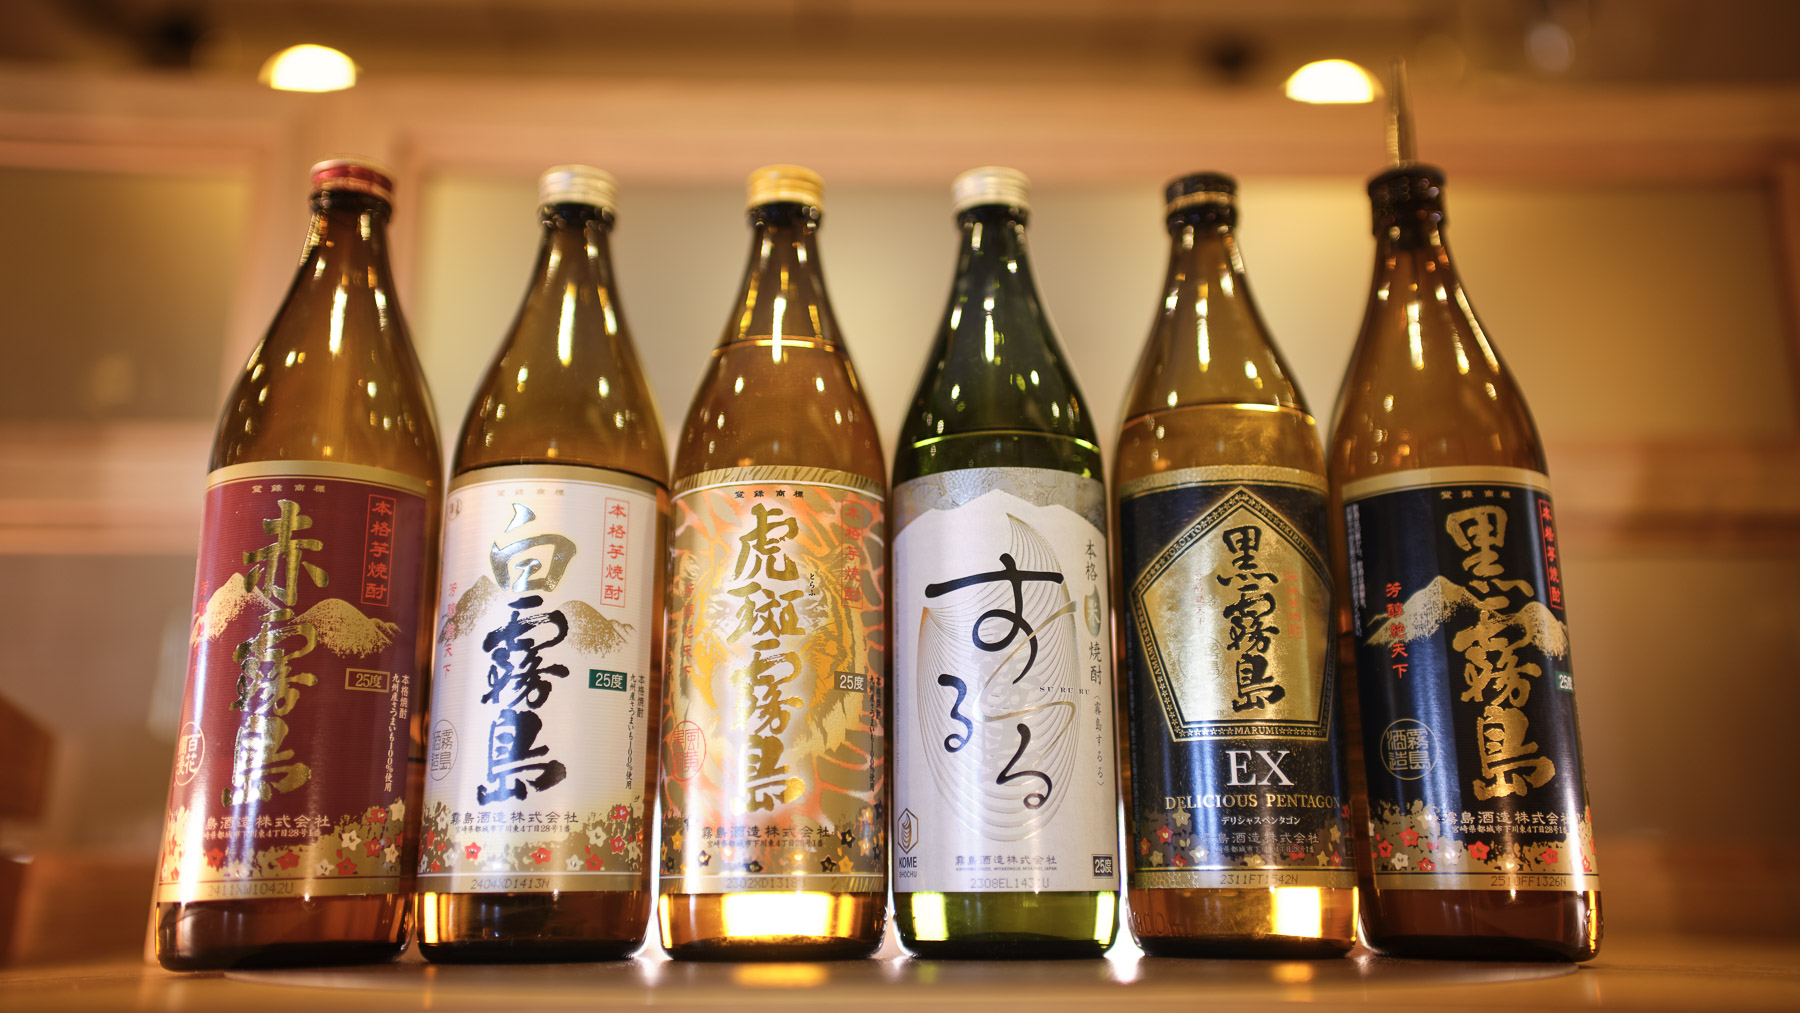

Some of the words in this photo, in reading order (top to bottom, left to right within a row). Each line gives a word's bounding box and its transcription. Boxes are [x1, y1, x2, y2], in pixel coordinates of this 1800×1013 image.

[365, 501, 392, 599] 本格芋焼酎
[1164, 524, 1202, 560] TOROTTO
[603, 504, 627, 600] 本格芋焼酎
[808, 573, 816, 597] とらふ
[1217, 526, 1286, 713] 黒霧島
[222, 499, 329, 808] 赤霧島
[477, 503, 577, 806] 白霧島
[727, 503, 806, 816] 虎斑霧島
[1146, 640, 1162, 675] AMAMI
[1446, 505, 1556, 800] 黒霧島
[355, 673, 382, 688] 25度
[595, 672, 623, 690] 25度
[839, 675, 864, 690] 25度
[1234, 727, 1279, 735] MARUMI
[1226, 750, 1294, 786] EX
[1165, 794, 1258, 810] DELICIOUS
[1266, 794, 1340, 810] PENTAGON
[450, 811, 579, 825] 霧島酒造株式会社
[1221, 816, 1301, 825] デリシャスペンタゴン
[702, 826, 831, 839] 霧島酒造株式会社
[899, 857, 917, 868] KOME
[955, 855, 1057, 865] 霧島酒造株式会社
[1094, 859, 1112, 873] 25度
[970, 878, 1050, 889] 2308EL143U
